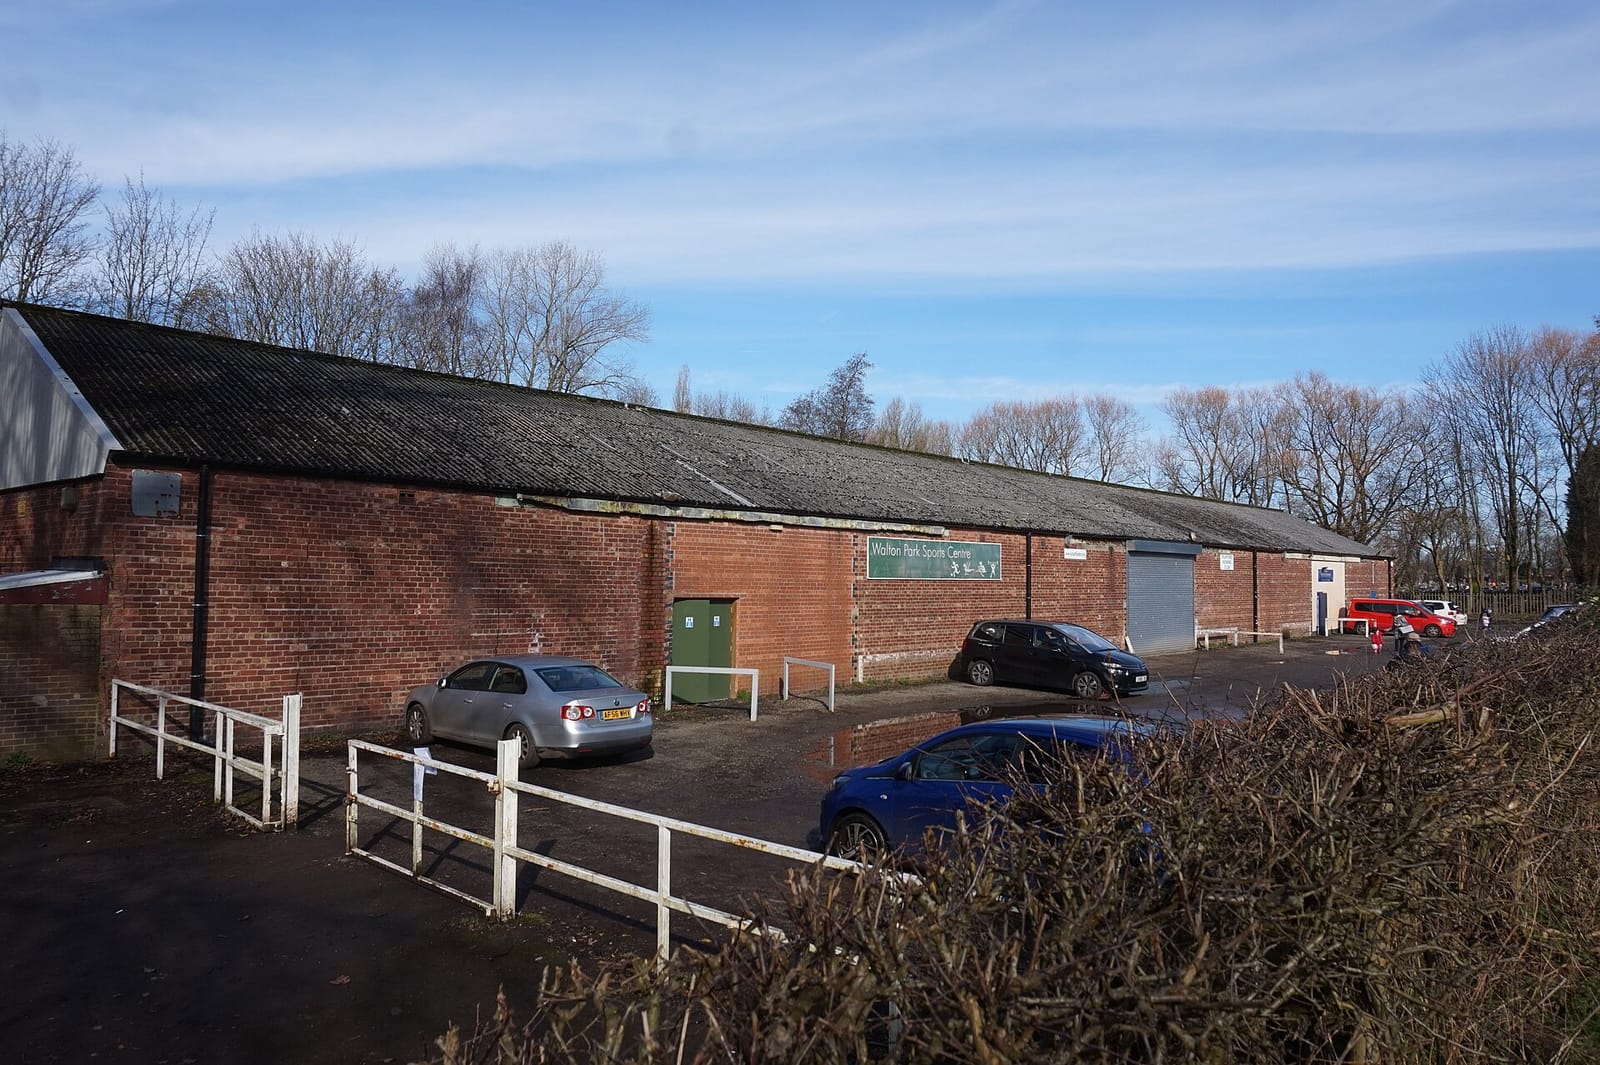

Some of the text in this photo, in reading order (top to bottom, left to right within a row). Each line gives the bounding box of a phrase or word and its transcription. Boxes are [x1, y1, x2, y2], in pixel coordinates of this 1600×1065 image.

[872, 542, 971, 560] Walton Park Sports Centre
